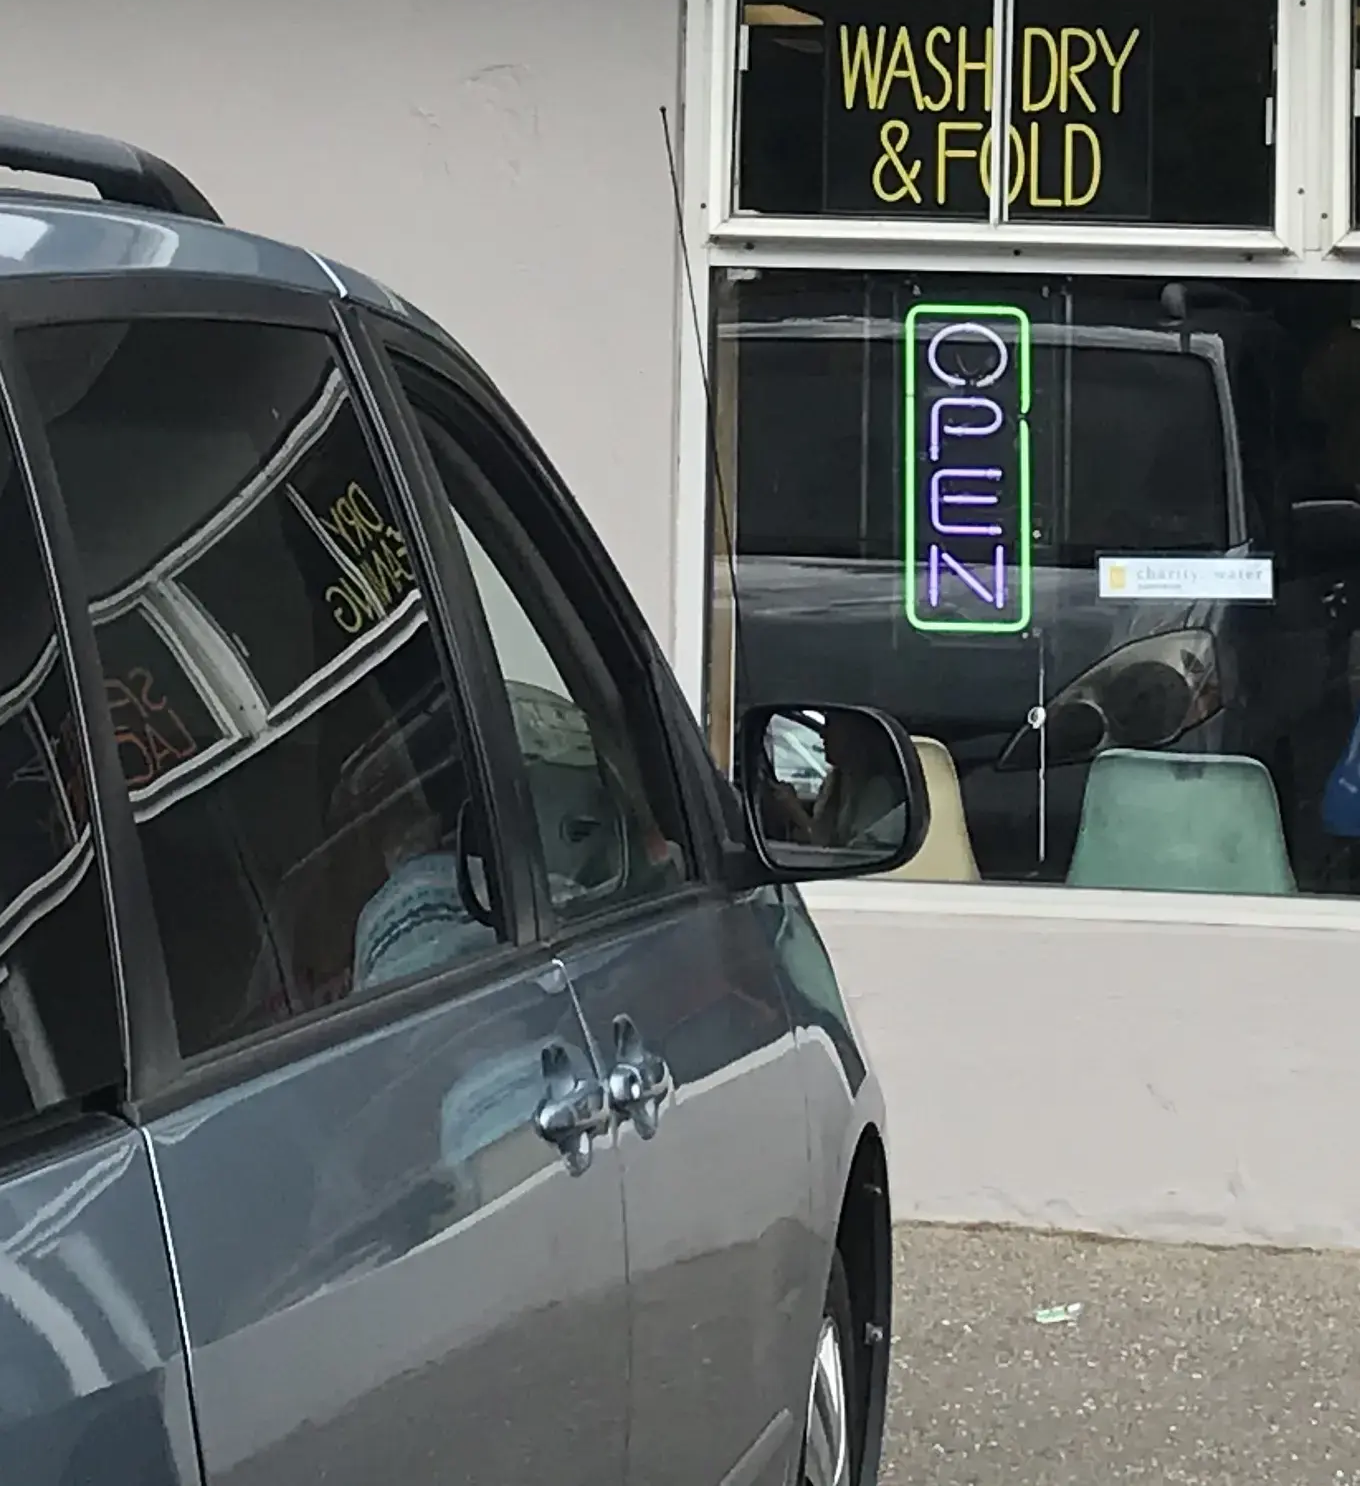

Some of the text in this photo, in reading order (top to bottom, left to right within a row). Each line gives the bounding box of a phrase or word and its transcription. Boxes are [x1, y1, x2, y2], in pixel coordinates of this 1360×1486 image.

[840, 24, 1140, 114] WASH DRY
[871, 118, 1102, 207] & FOLD
[927, 321, 1009, 610] OPEN
[1213, 568, 1264, 581] water
